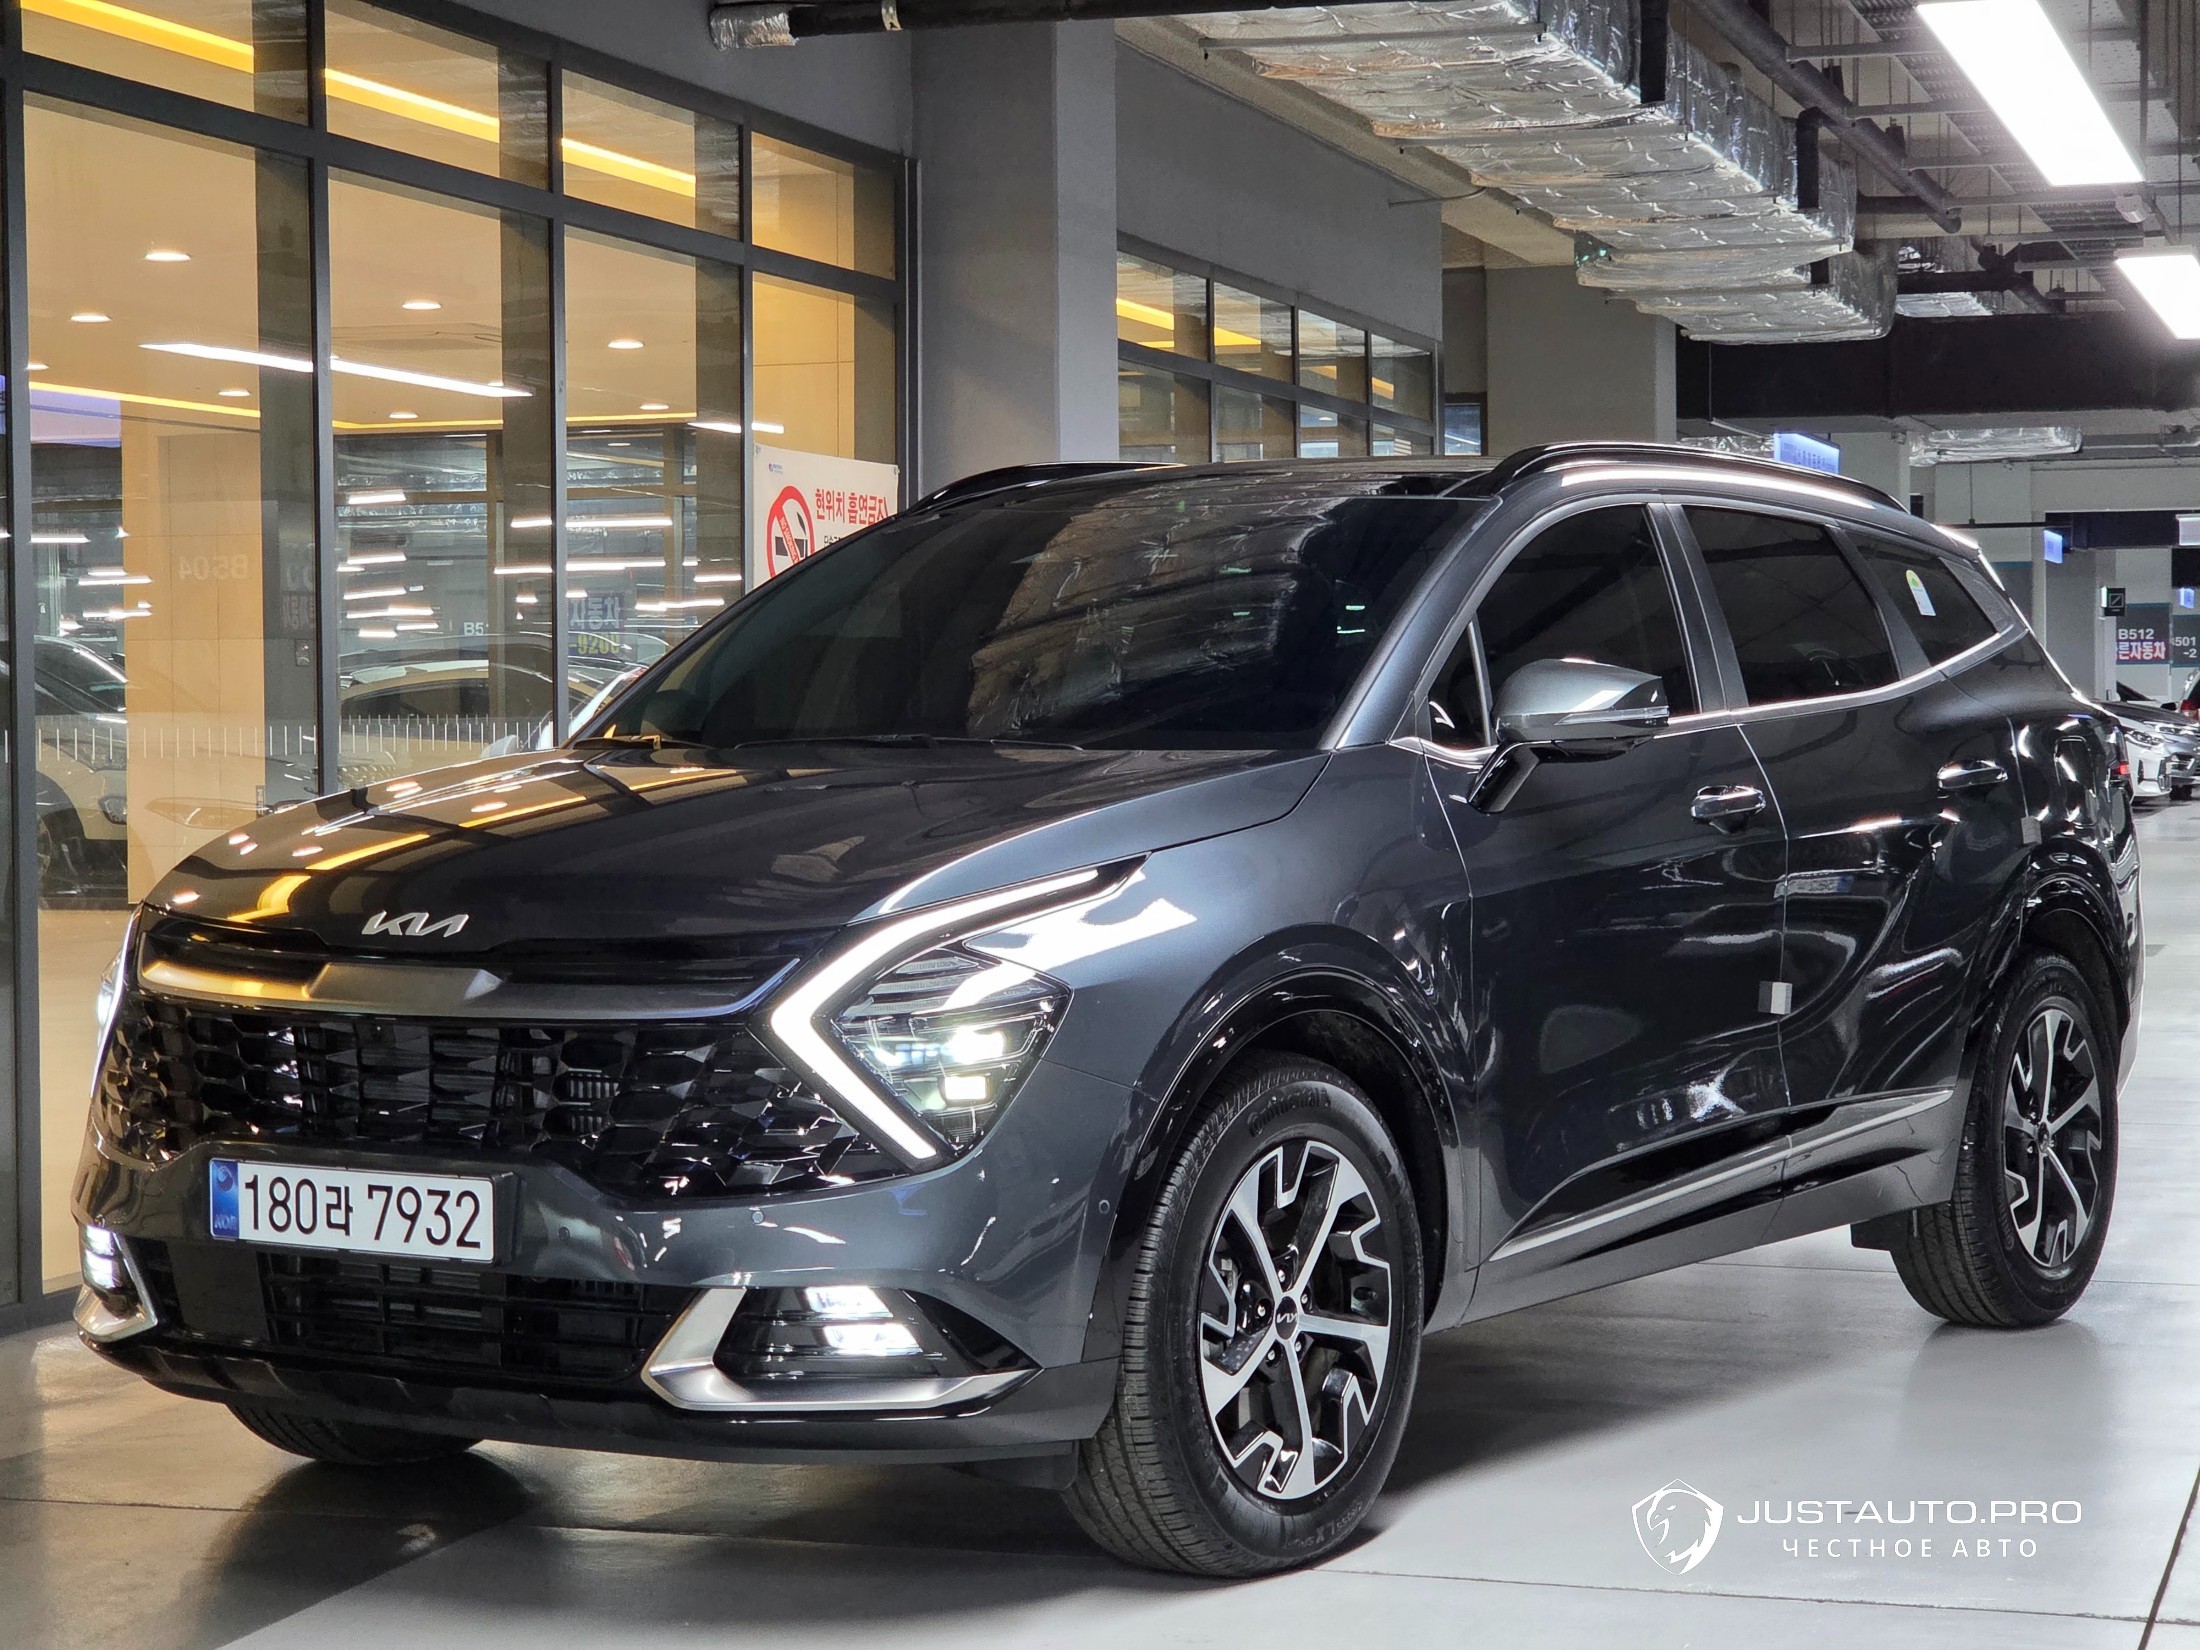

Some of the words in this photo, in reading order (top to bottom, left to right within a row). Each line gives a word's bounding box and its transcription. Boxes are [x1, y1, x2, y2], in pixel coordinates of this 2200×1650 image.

[815, 488, 846, 523] 현위치
[848, 492, 889, 526] 흡연금지
[463, 621, 489, 637] B5
[2117, 628, 2155, 640] B512
[2116, 641, 2166, 660] 른자동차
[2182, 648, 2198, 659] -2
[361, 910, 470, 938] KIA
[245, 1174, 353, 1237] 180라
[367, 1184, 481, 1249] 7932
